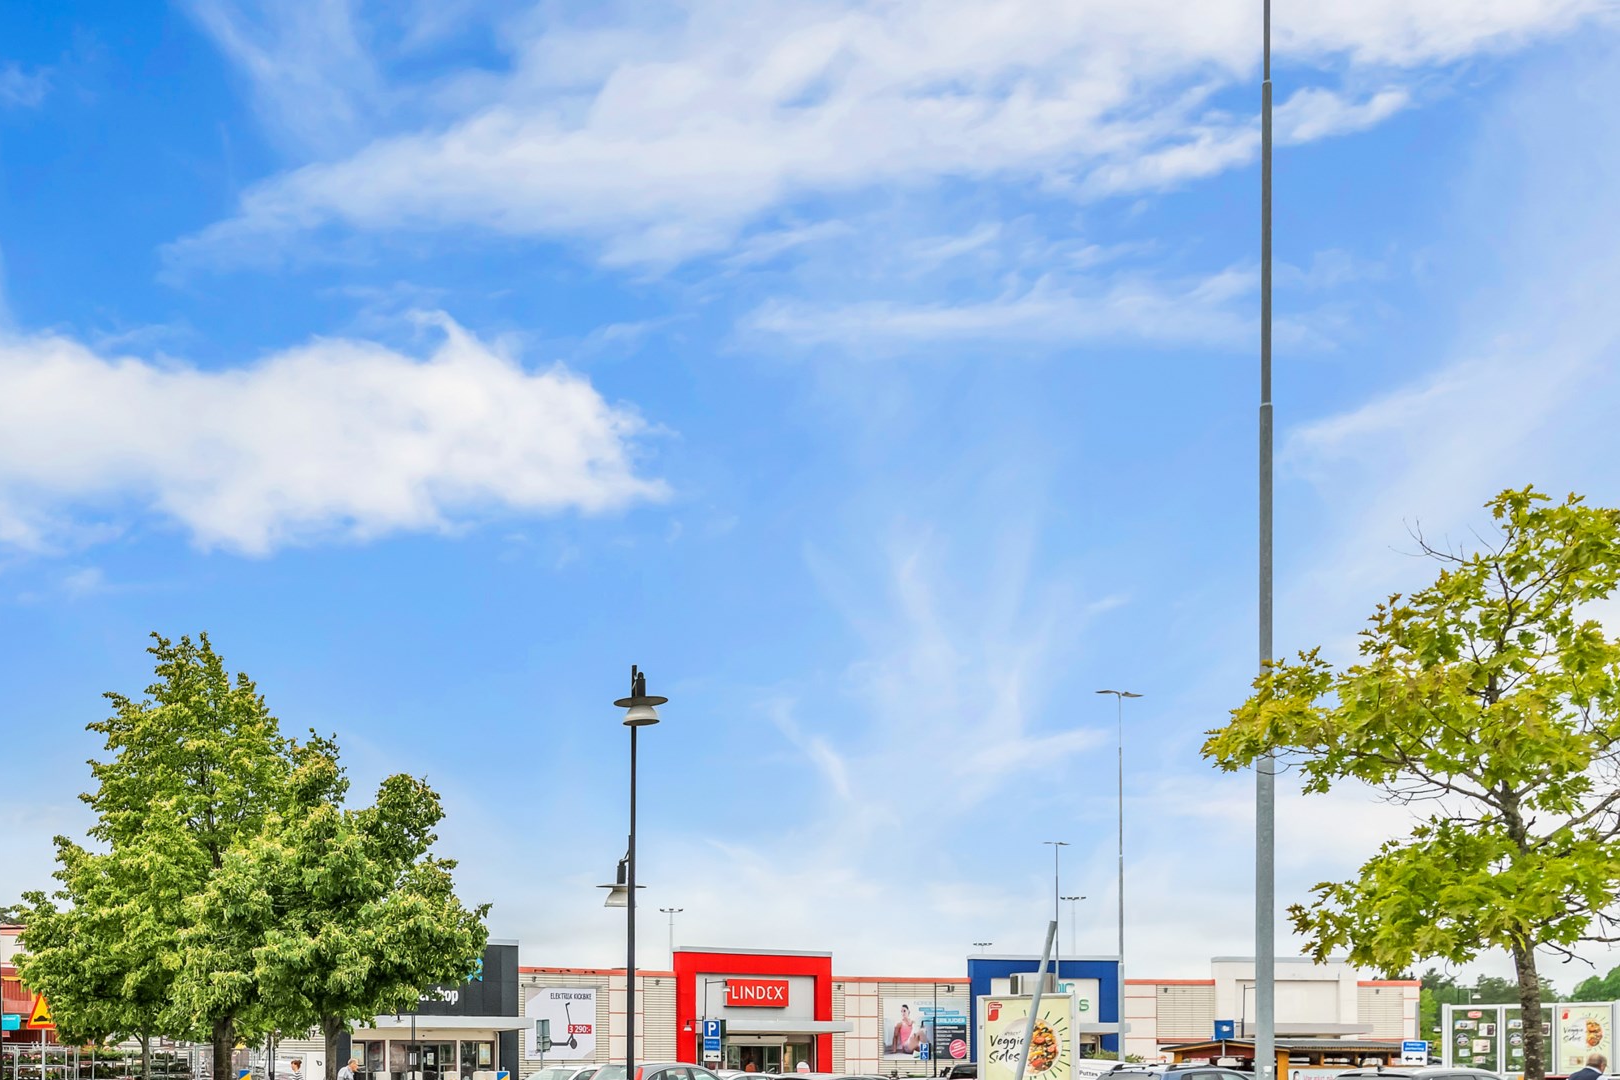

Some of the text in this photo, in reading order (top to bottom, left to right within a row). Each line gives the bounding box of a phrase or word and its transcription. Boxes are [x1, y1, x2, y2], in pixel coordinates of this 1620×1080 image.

[731, 985, 784, 1000] LINDEX
[569, 1025, 574, 1033] 3
[708, 1021, 717, 1036] P
[990, 1034, 1024, 1050] Veggie
[989, 1050, 1020, 1064] Sides
